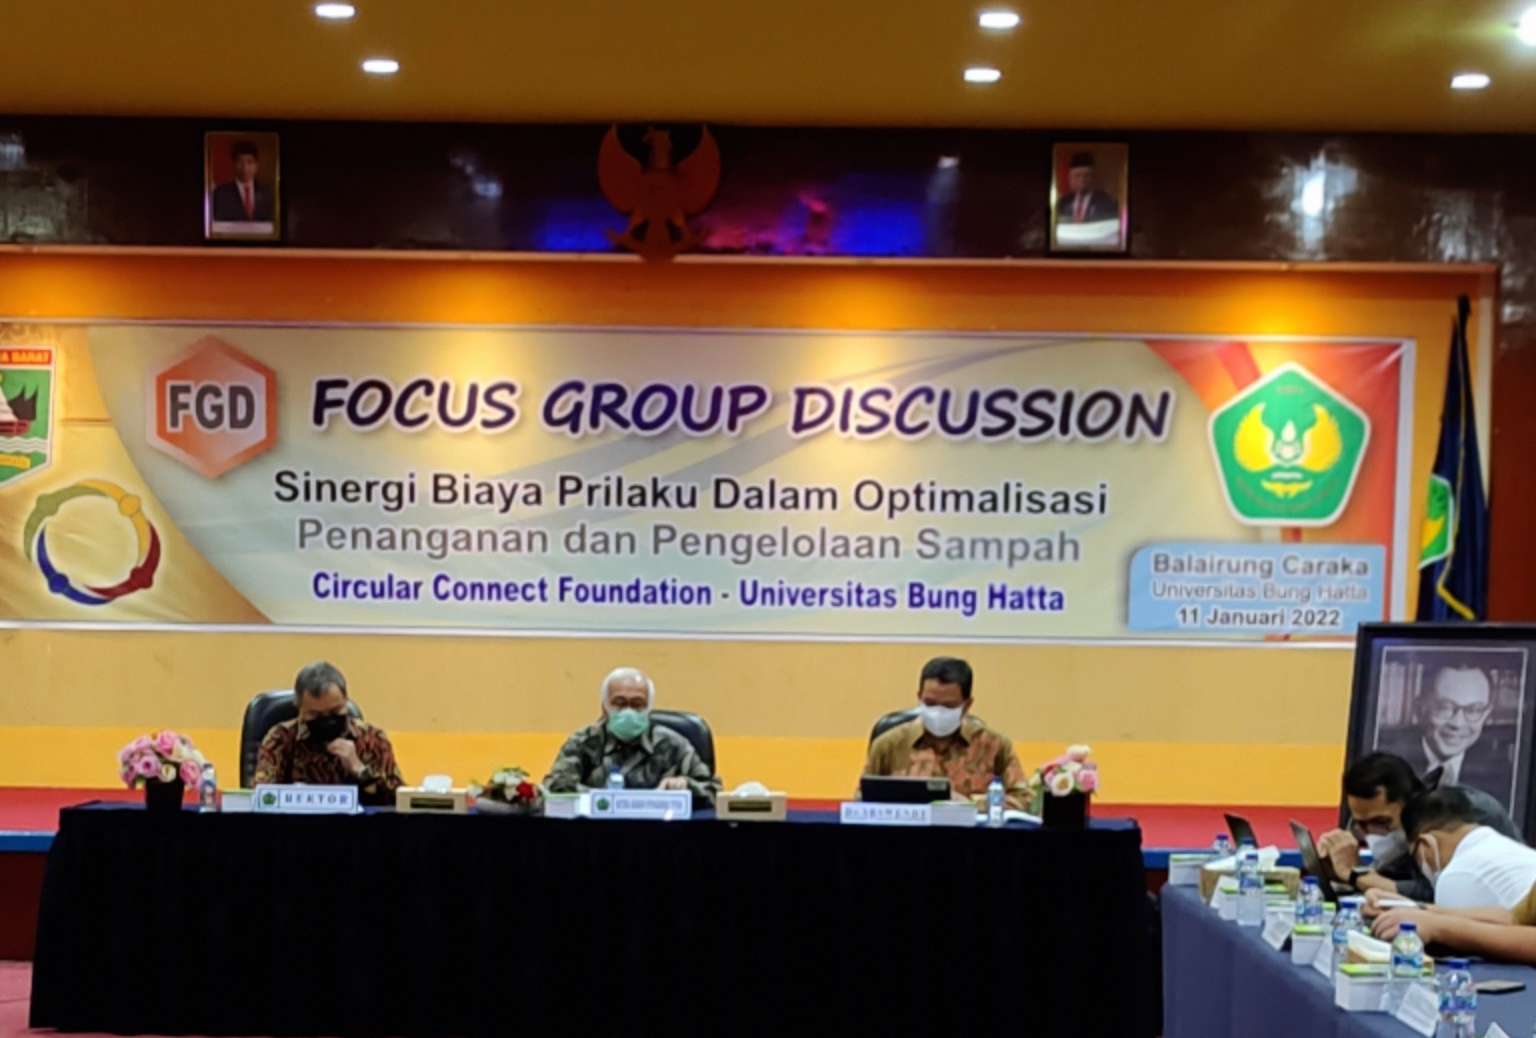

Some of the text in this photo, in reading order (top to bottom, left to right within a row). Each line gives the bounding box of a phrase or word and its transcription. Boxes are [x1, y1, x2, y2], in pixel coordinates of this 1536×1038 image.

[169, 384, 256, 430] FGD
[313, 378, 1170, 439] FOCUS GROUP DISCUSSION
[274, 471, 1107, 520] Sinergi Biaya Prilaku Dalam Optimalisasi
[298, 518, 1080, 569] Penanganan dan Pengelolaan Sampah
[1153, 553, 1369, 578] Balairung Caraka
[313, 572, 423, 602] Circular
[432, 574, 548, 602] Connect
[559, 576, 712, 606] Foundation
[740, 579, 897, 609] Universitas
[908, 582, 977, 617] Bung
[987, 583, 1064, 611] Hatta
[1152, 581, 1367, 603] Universitas Bung Hatta
[1179, 608, 1340, 626] 11 Januari 2022
